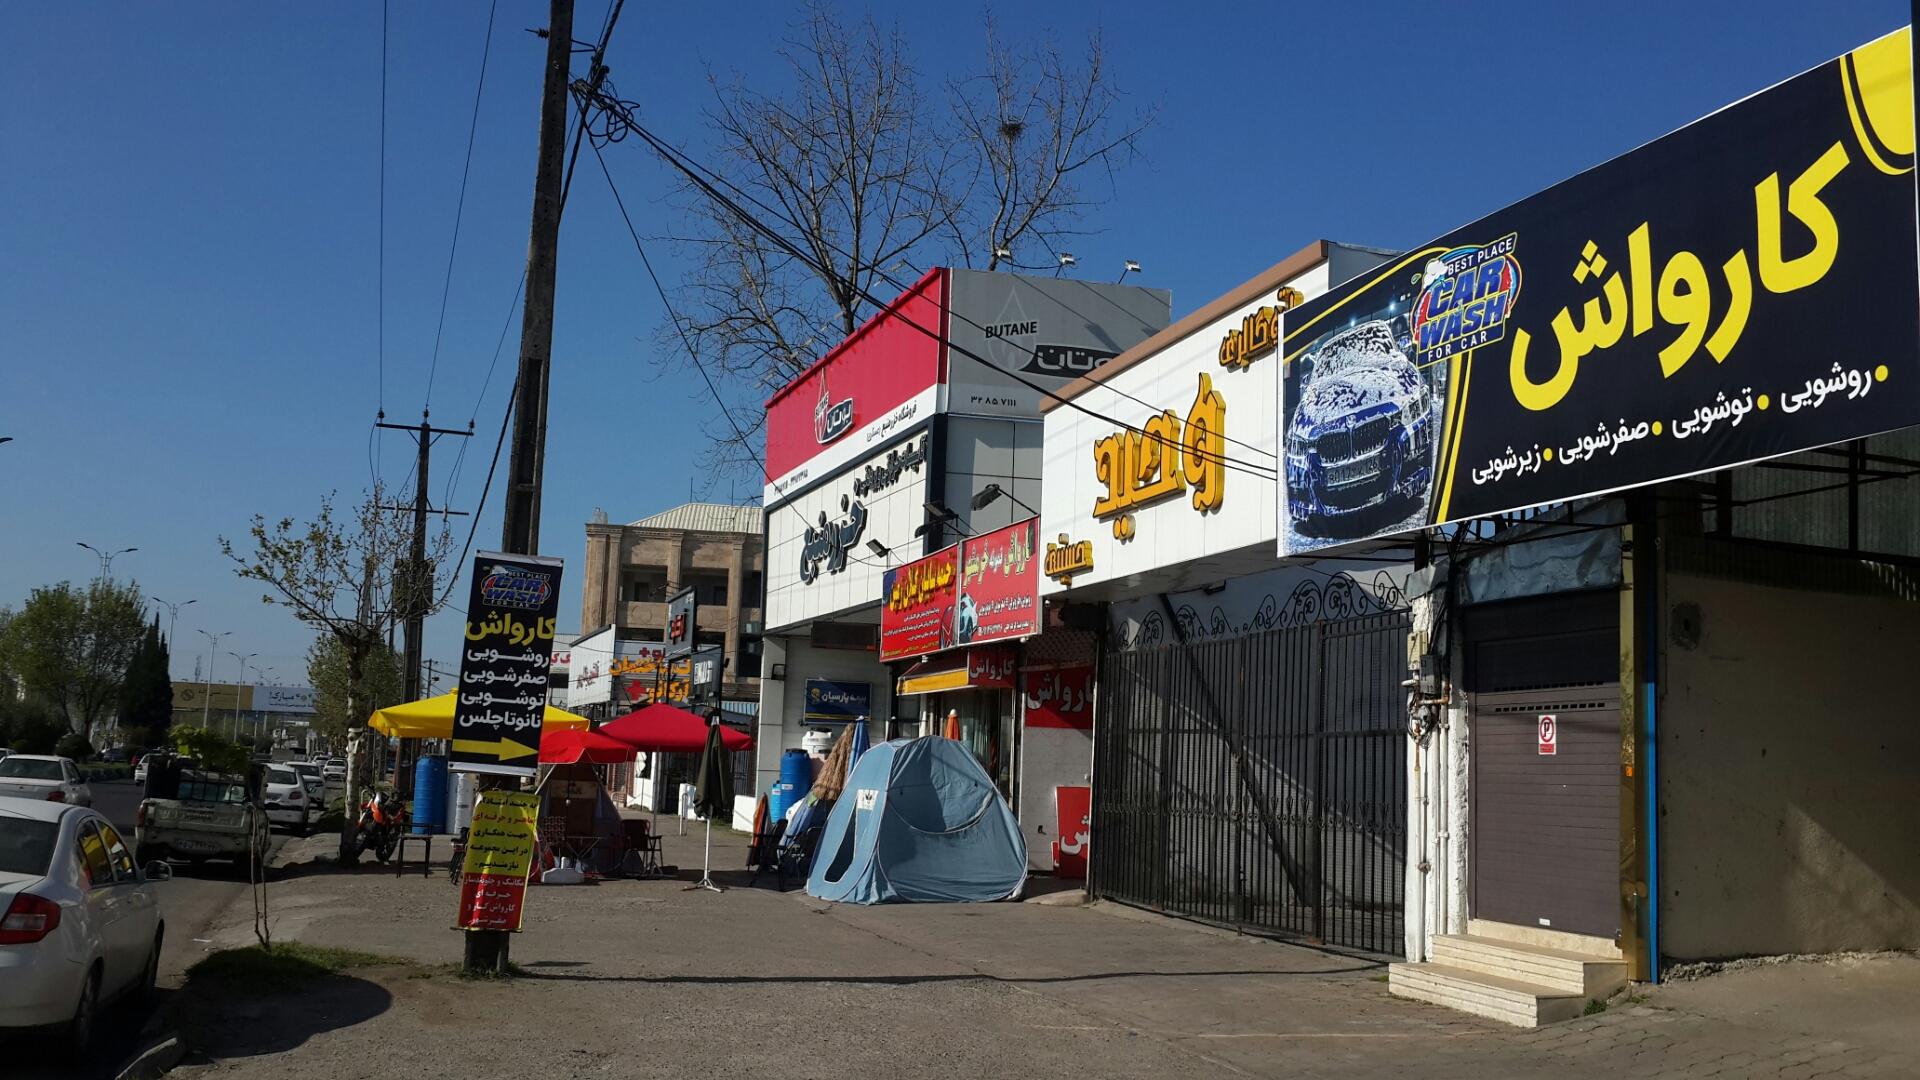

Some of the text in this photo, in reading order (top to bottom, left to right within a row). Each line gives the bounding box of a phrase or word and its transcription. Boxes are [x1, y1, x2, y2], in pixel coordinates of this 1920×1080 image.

[1448, 238, 1513, 275] BEST PLACE
[1426, 256, 1506, 320] CAR
[1510, 141, 1851, 411] کارواش
[985, 321, 1038, 339] BUTANE
[1419, 291, 1508, 353] WASH
[1428, 331, 1487, 362] FOR CAR
[1472, 361, 1872, 485] روشویی توشویی صفرشویی زیرشویی
[486, 588, 544, 605] WASH
[494, 576, 544, 593] CAR
[465, 610, 556, 646] کارواش
[467, 647, 550, 668] روشویی
[969, 651, 1015, 680] کارواش
[463, 667, 547, 686] صفرشویی
[461, 689, 545, 711] توشویی
[821, 691, 850, 704] پارسیان
[1027, 673, 1095, 713] ارواش
